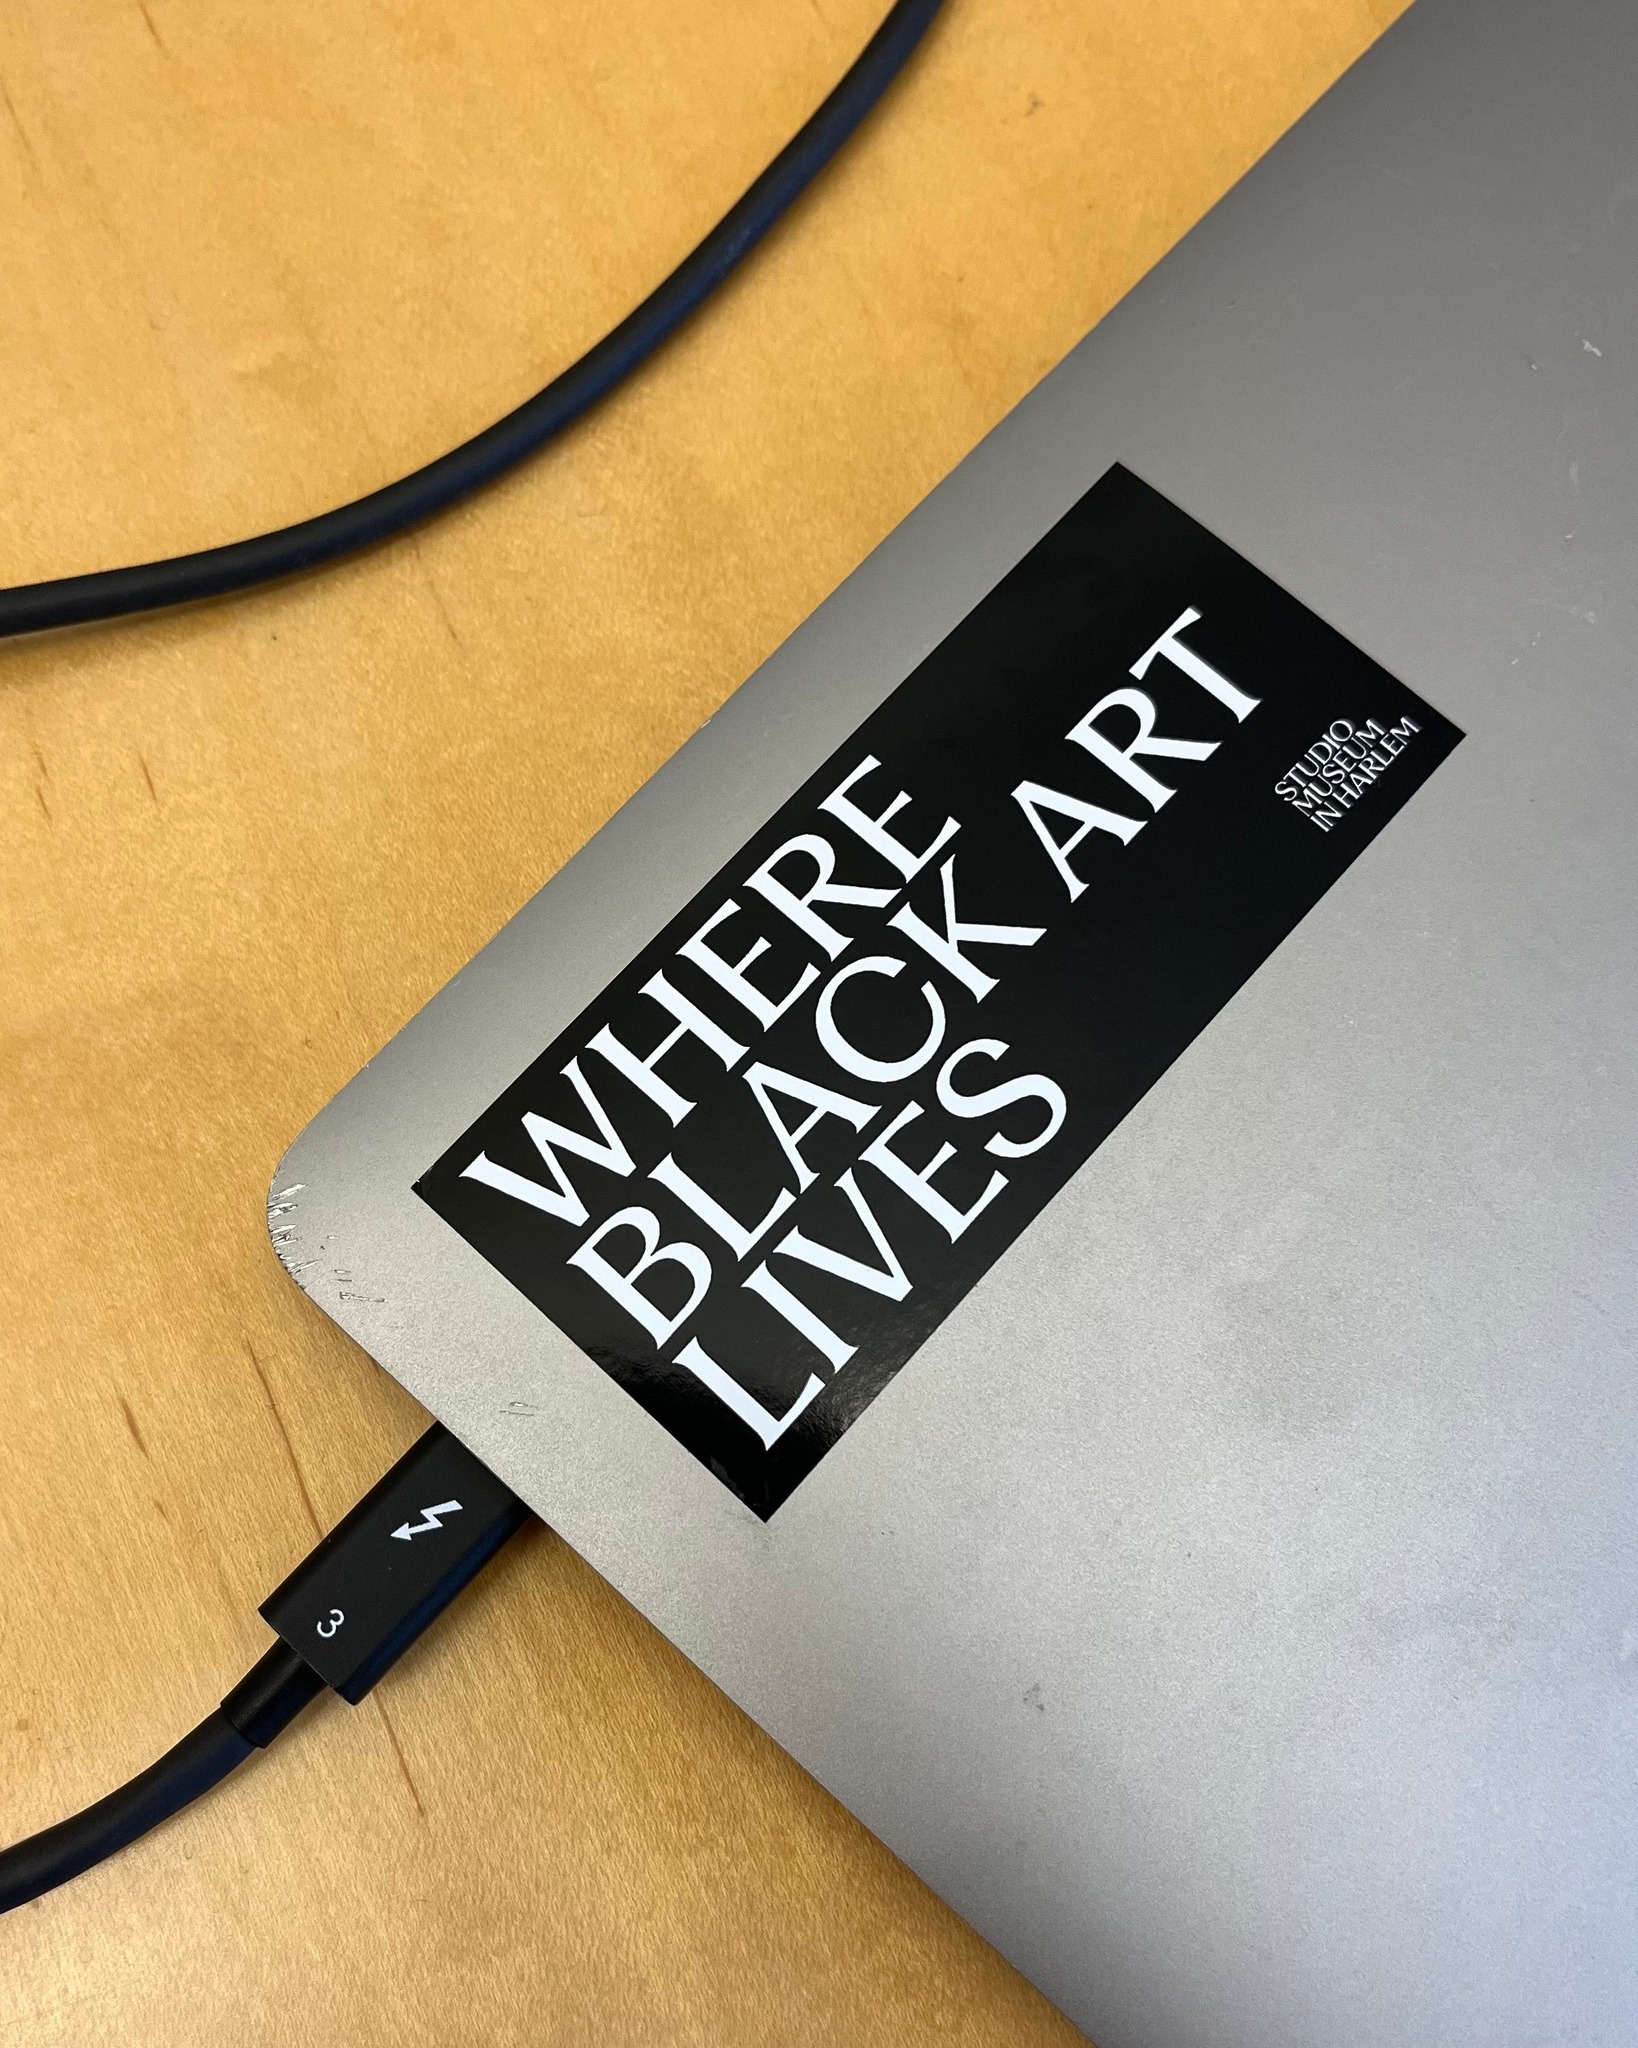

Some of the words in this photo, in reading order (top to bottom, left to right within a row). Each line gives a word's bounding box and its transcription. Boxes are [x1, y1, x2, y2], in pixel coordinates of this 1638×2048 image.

[1274, 719, 1354, 801] STUDIO
[1291, 718, 1386, 817] MUSEUM
[1309, 801, 1343, 833] IN
[1331, 716, 1421, 809] HARLEM
[459, 755, 961, 1226] WHERE
[566, 854, 1047, 1349] BLACK
[1011, 607, 1260, 903] ART
[672, 1039, 1066, 1451] LIVES
[316, 1608, 345, 1638] 3
